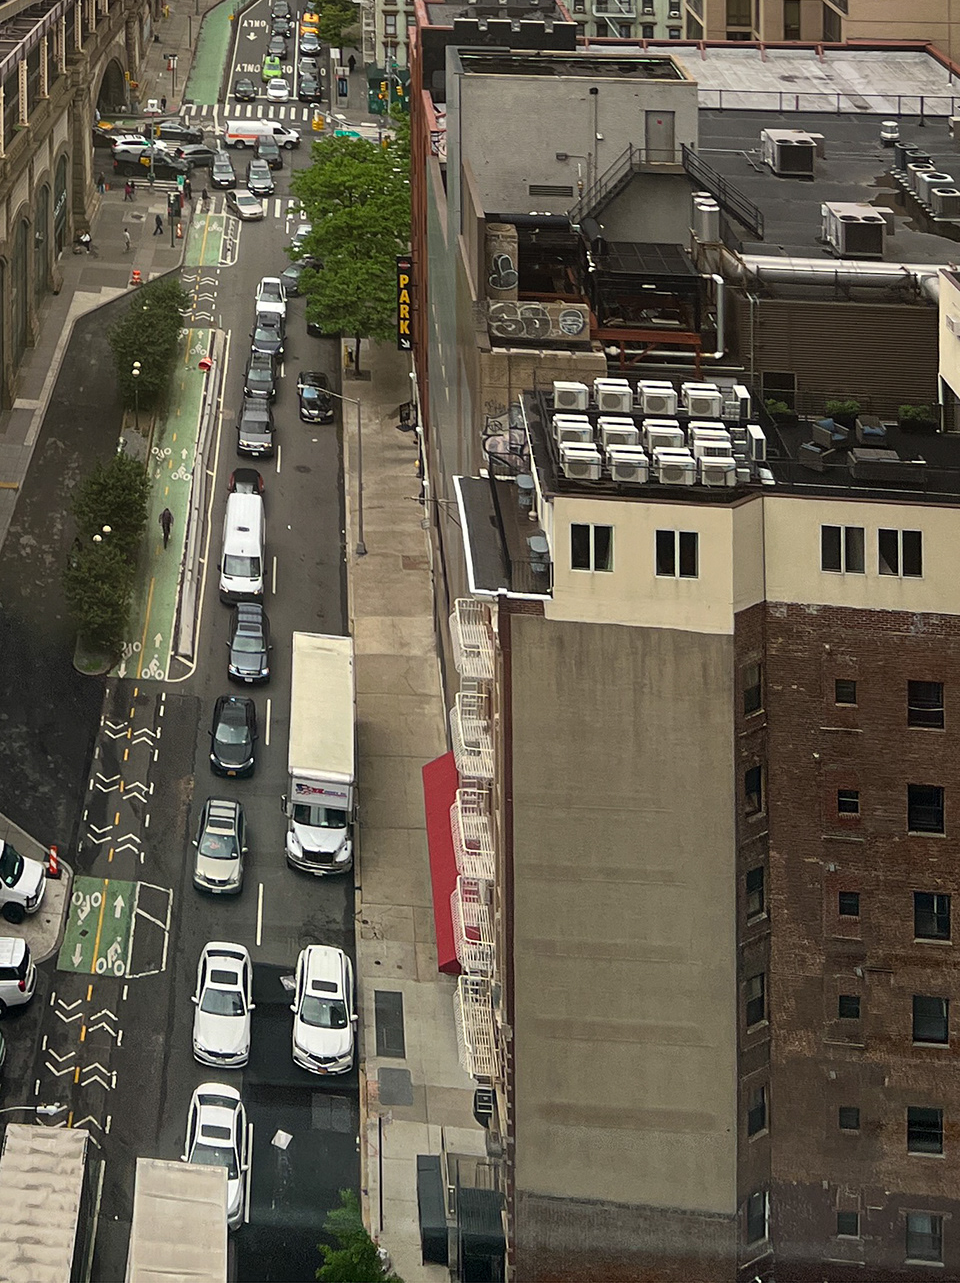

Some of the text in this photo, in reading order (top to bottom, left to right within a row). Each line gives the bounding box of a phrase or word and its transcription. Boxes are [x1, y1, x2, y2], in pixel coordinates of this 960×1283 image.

[243, 20, 266, 28] ONLY
[235, 63, 261, 73] ONLY
[399, 274, 411, 335] PARK
